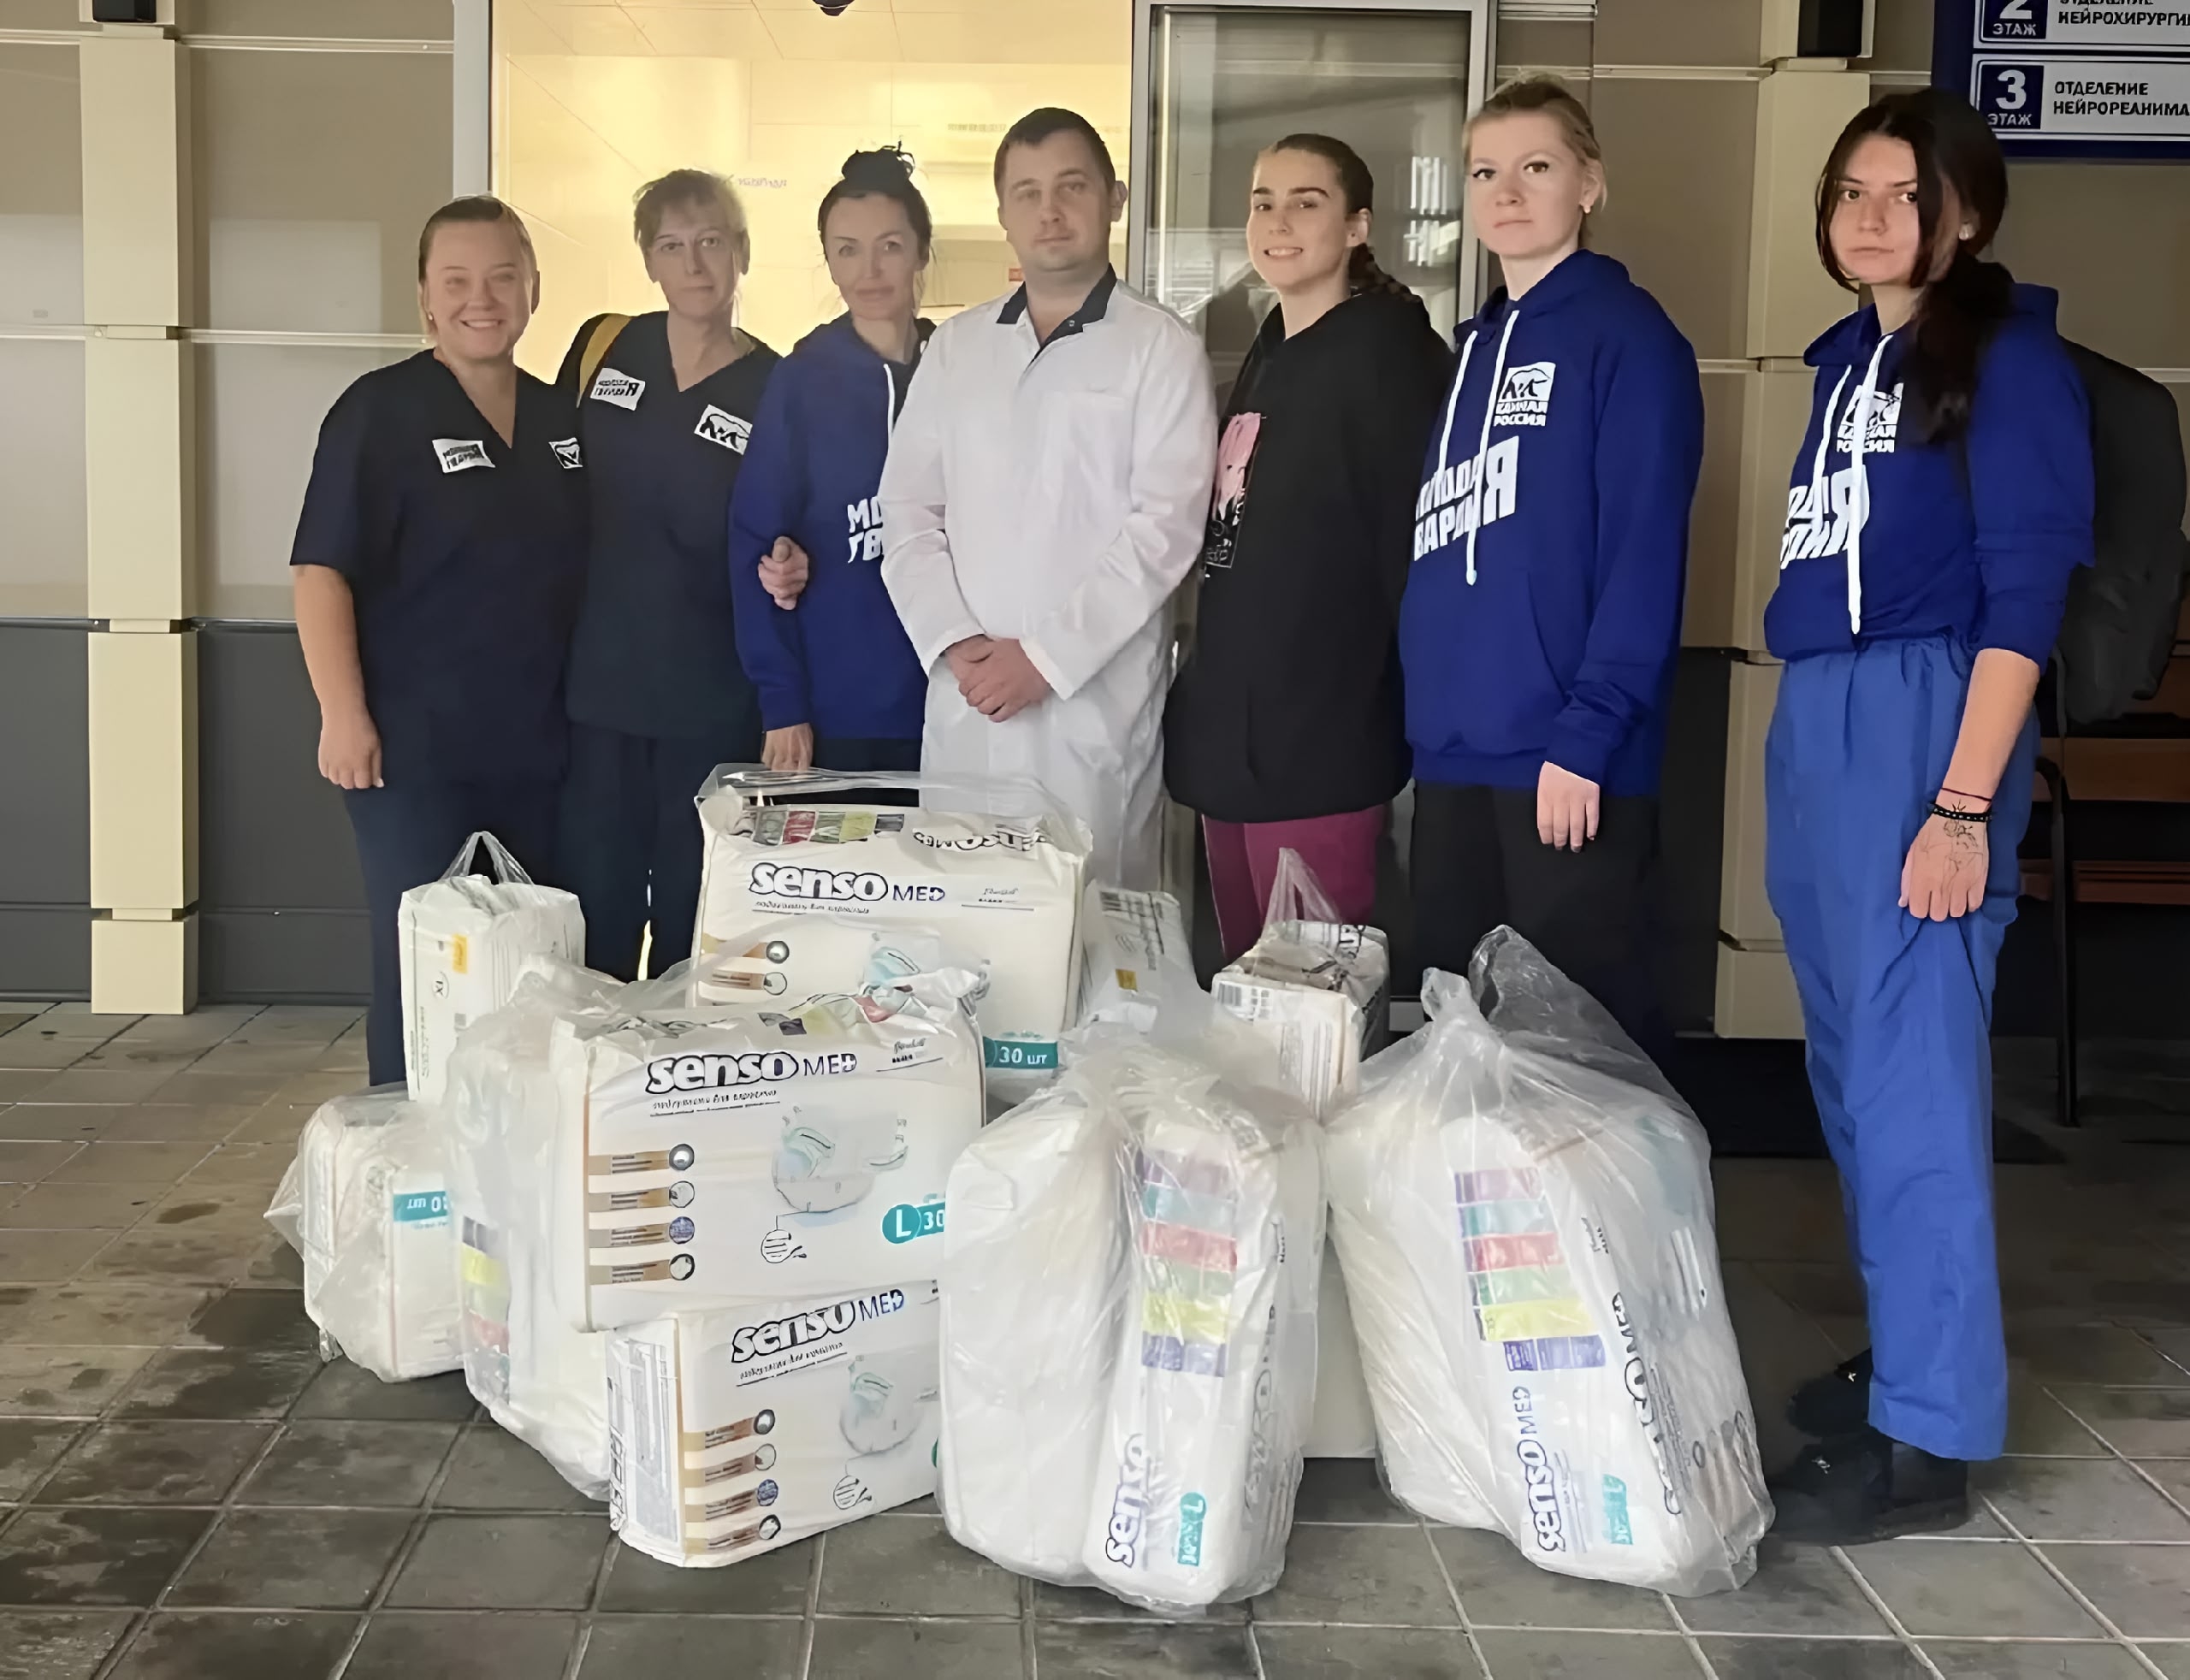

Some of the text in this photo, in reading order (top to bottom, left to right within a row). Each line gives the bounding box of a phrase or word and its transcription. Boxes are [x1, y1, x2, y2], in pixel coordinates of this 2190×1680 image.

[1992, 23, 2036, 36] ЭТАЖ
[2058, 8, 2190, 27] НЕЙРОХИРУРГИ
[1995, 69, 2027, 109] 3
[2055, 81, 2148, 96] ОТДЕЛЕНИЕ
[1988, 113, 2032, 126] ЭТАЖ
[749, 862, 945, 902] senso MED
[999, 1046, 1047, 1065] 30 шт
[645, 1051, 857, 1094] senso MED
[896, 1209, 912, 1238] L
[731, 1300, 856, 1363] senso
[859, 1289, 904, 1321] MED
[1516, 1440, 1566, 1552] senso
